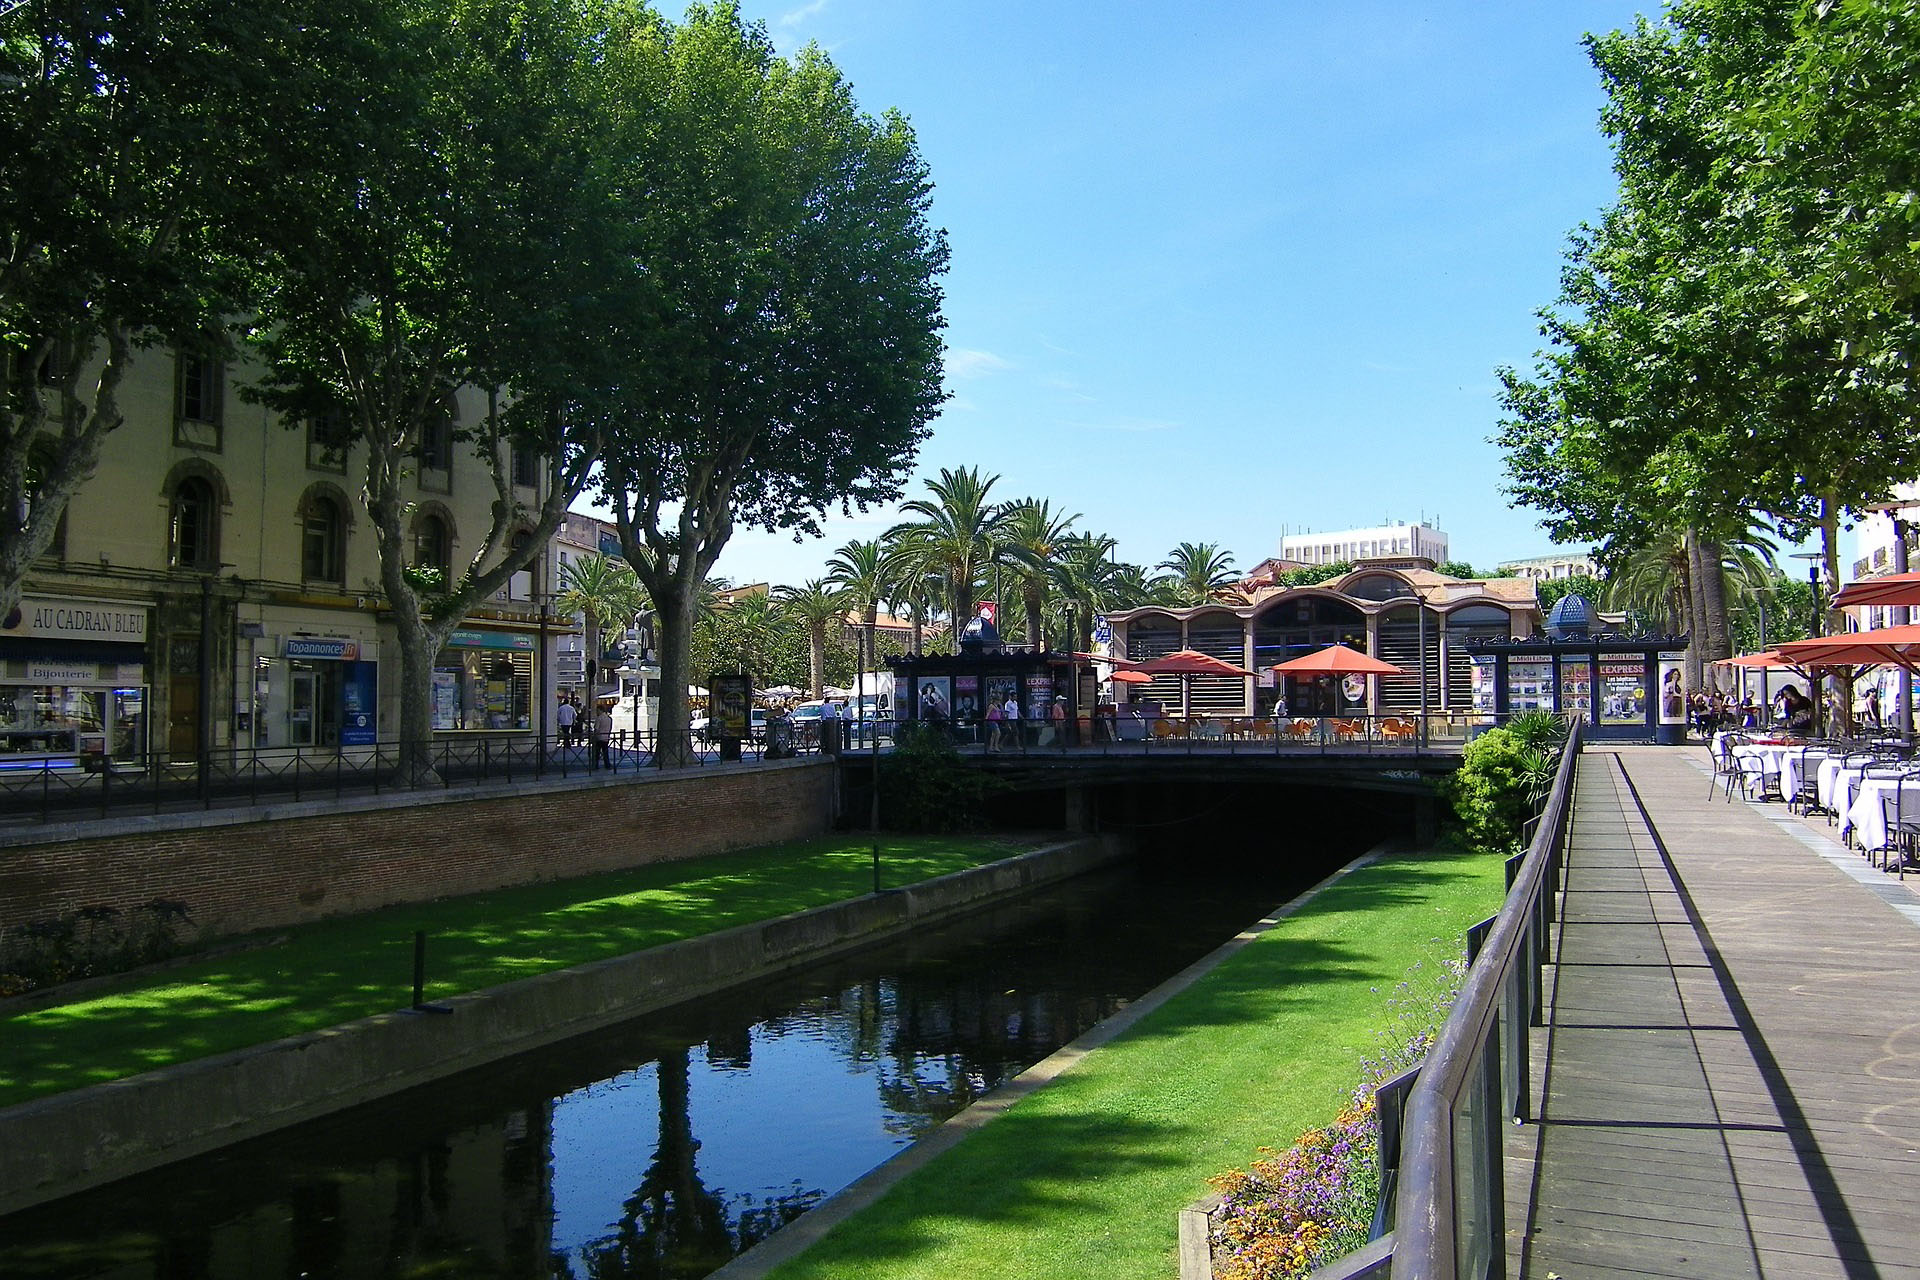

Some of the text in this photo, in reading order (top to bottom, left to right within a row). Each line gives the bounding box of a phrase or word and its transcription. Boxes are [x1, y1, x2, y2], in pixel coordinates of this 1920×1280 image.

[33, 608, 144, 633] AU CADRAN BLEU
[33, 668, 93, 680] Bijouterie
[1600, 665, 1644, 674] L'EXPRESS
